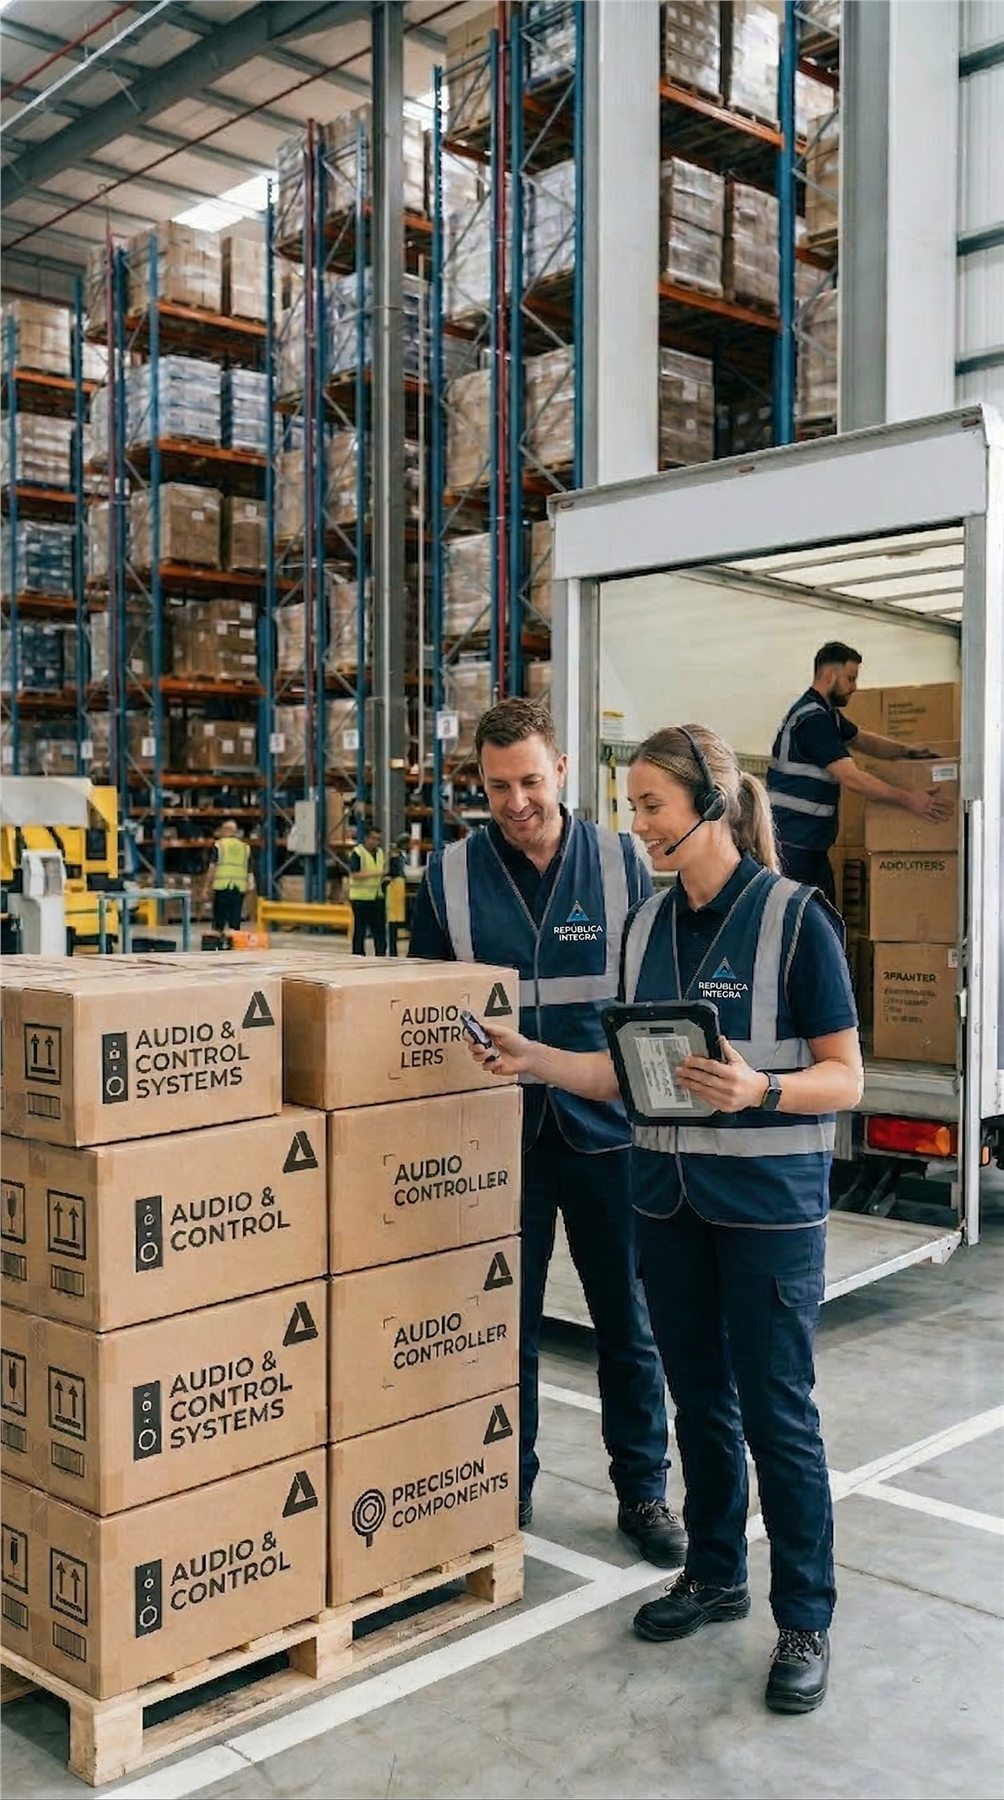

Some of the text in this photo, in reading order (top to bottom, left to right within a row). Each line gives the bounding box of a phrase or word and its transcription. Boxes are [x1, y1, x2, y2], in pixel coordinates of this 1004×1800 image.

[559, 933, 598, 942] INTEGRA
[702, 990, 742, 999] INTEGRA
[401, 1005, 459, 1026] AUDIO
[135, 1021, 236, 1050] AUDIO &
[135, 1042, 250, 1074] CONTROL
[401, 1048, 444, 1069] LERS
[136, 1066, 243, 1099] SYSTEMS
[394, 1155, 463, 1186] AUDIO
[394, 1170, 509, 1207] CONTROLLER
[170, 1186, 276, 1226] AUDIO &
[170, 1210, 291, 1252] CONTROL
[393, 1312, 462, 1348] AUDIO
[393, 1323, 508, 1370] CONTROLLER
[169, 1350, 277, 1398] AUDIO &
[170, 1373, 293, 1422] CONTROL
[170, 1398, 284, 1449] SYSTEMS
[392, 1457, 485, 1506] PRECISION
[392, 1472, 509, 1528] COMPONENTS
[170, 1531, 277, 1587] AUDIO &
[170, 1551, 291, 1611] CONTROL
